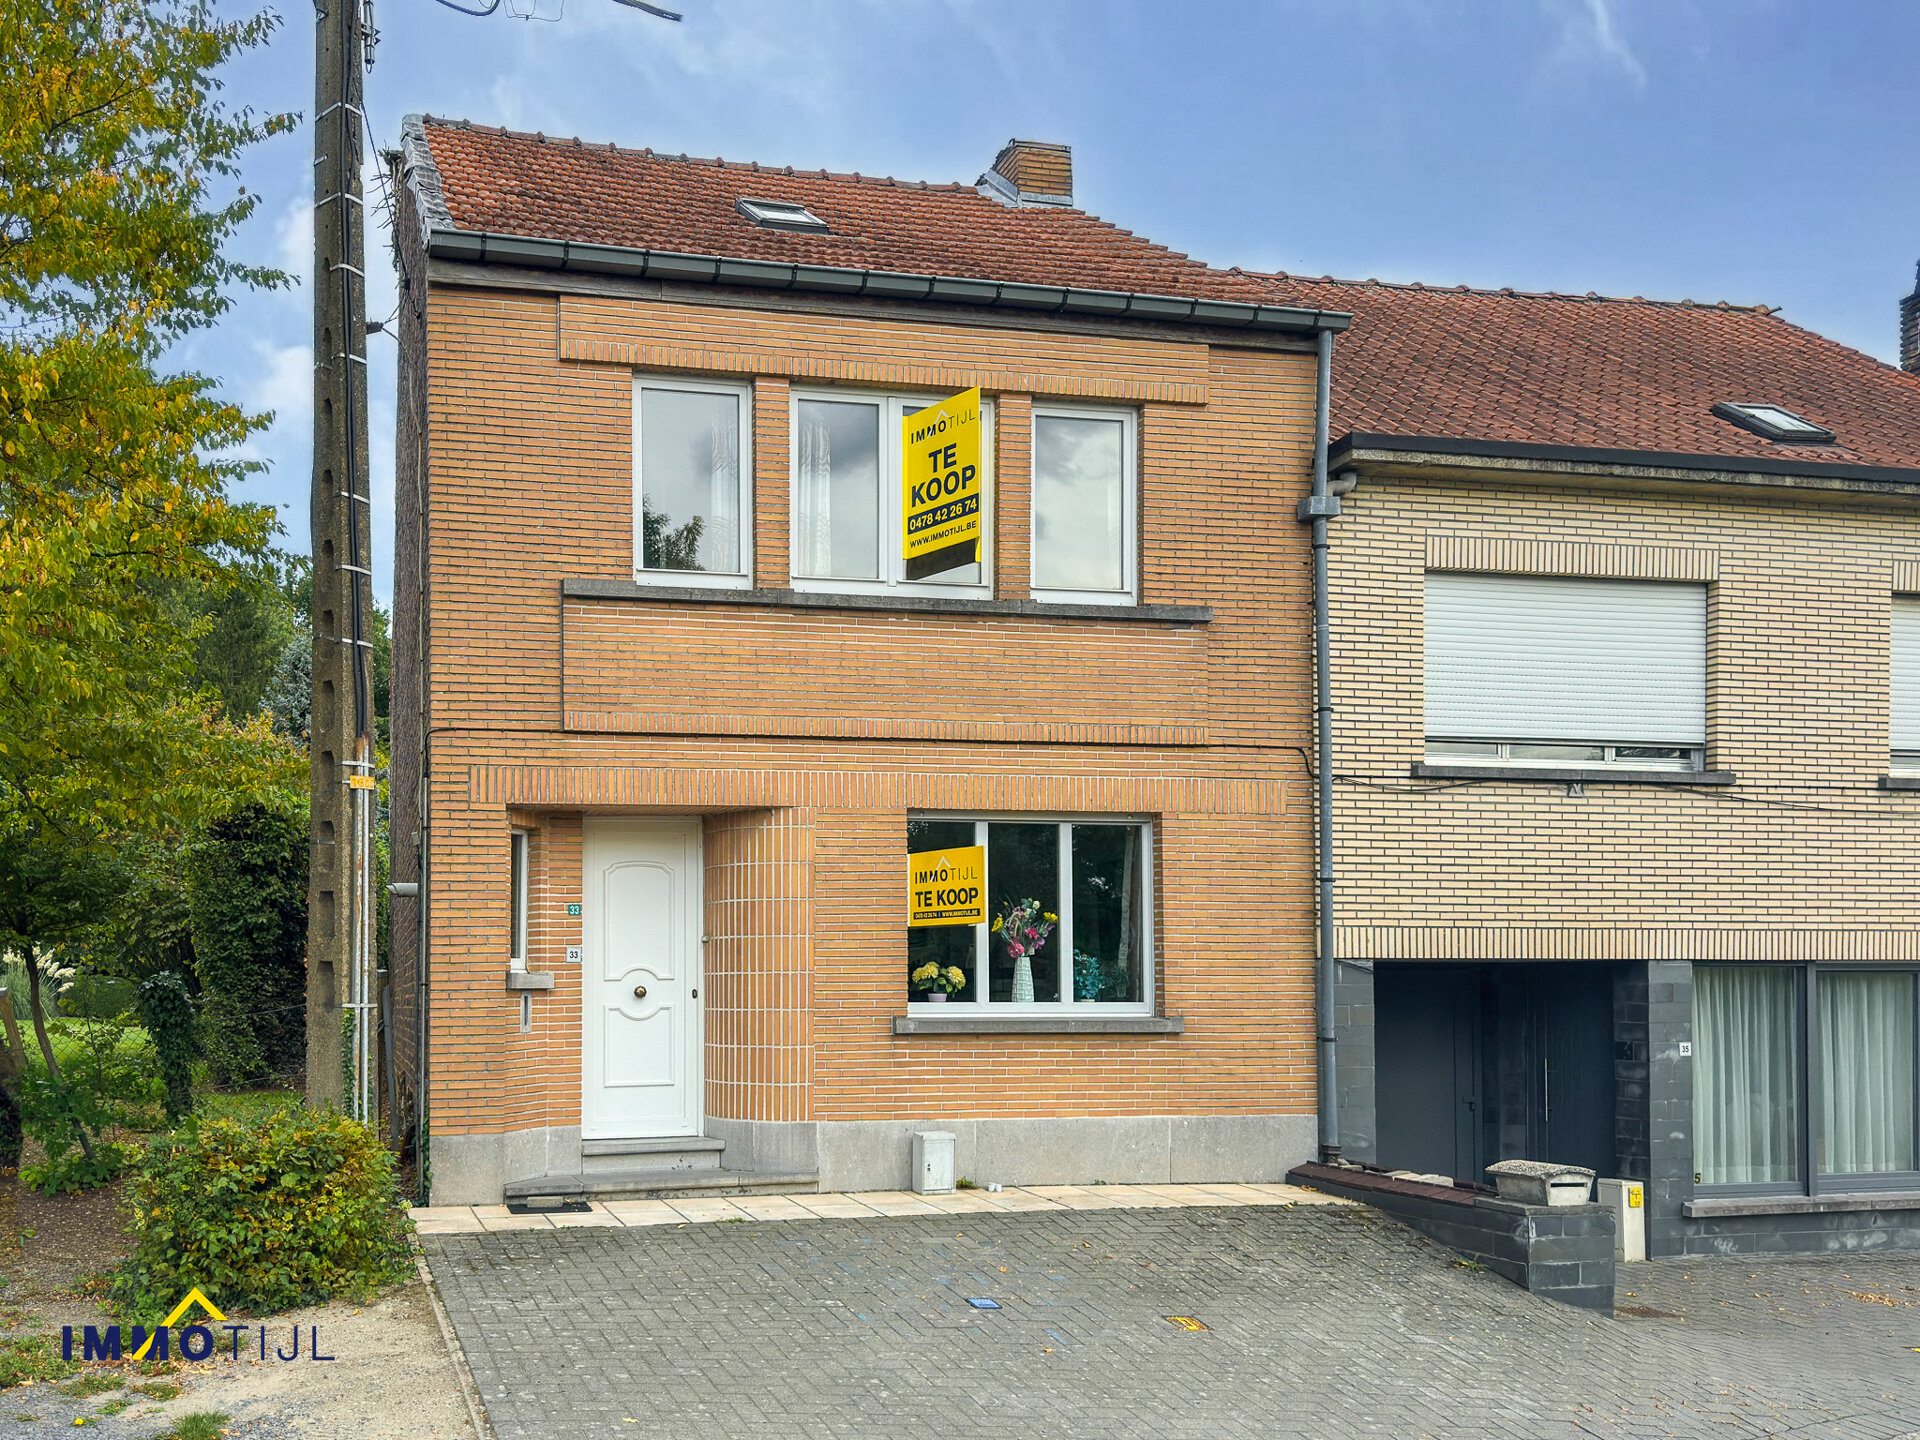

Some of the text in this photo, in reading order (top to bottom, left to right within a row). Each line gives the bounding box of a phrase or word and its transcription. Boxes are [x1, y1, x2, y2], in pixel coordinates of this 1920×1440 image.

[911, 409, 976, 445] IMMOTIJL
[928, 442, 957, 474] TE
[911, 464, 976, 508] KOOP
[909, 498, 977, 531] 0478 42 26 74
[910, 520, 977, 549] WWW.IMMOTIJL.BE
[914, 866, 978, 885] IMMOTIJL
[569, 905, 580, 915] 33
[915, 887, 979, 908] TE KOOP
[569, 950, 579, 959] 33
[1682, 1045, 1690, 1053] 35
